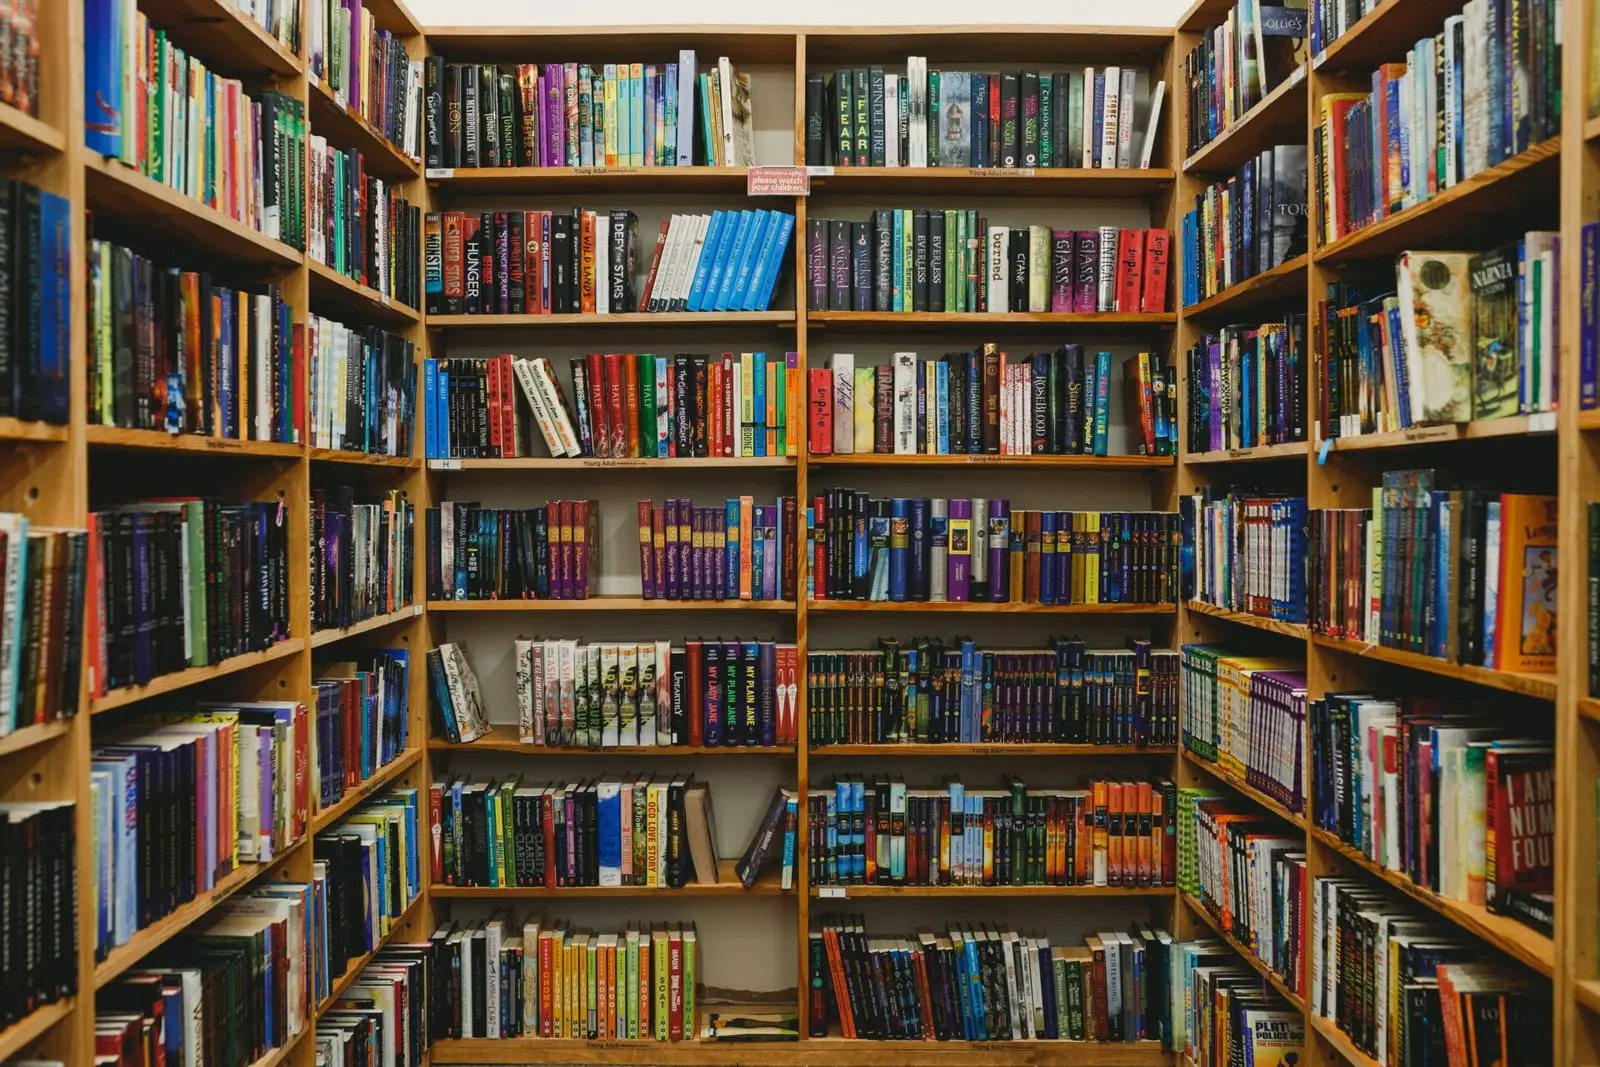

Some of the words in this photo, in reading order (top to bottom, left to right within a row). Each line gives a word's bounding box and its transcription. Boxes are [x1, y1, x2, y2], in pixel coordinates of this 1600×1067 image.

[449, 102, 461, 133] EON
[873, 77, 884, 125] SPINDLE
[466, 100, 476, 152] METROPOLITANS
[483, 111, 497, 142] TUNNELS
[501, 113, 514, 151] TUNNELS
[523, 115, 535, 148] DEEPER
[840, 100, 850, 150] FEAR
[858, 100, 868, 150] FEAR
[874, 129, 884, 153] FIRE
[753, 176, 777, 186] please
[779, 177, 803, 185] watch
[445, 229, 460, 262] SILVER
[583, 236, 593, 263] WILD
[613, 223, 624, 251] DEFY
[426, 232, 440, 284] MONSTER
[467, 242, 480, 298] HUNGER
[814, 244, 827, 287] wicked
[835, 245, 848, 289] wicked
[859, 249, 872, 289] wicked
[879, 231, 891, 287] CRUSADE
[915, 235, 926, 283] EVERLESS
[930, 236, 942, 284] EVERLESS
[991, 232, 1004, 282] burned
[1014, 252, 1026, 285] CRANK
[1059, 239, 1072, 285] GLASS
[1083, 239, 1095, 284] GLASS
[444, 265, 460, 295] STARS
[583, 267, 593, 298] LANDS
[613, 264, 624, 299] STARS
[593, 384, 601, 409] HALF
[611, 384, 620, 409] HALF
[627, 384, 635, 409] HALF
[643, 384, 652, 409] HALF
[1034, 374, 1048, 437] ROSEBLOOD
[1086, 374, 1094, 408] MISSION
[743, 428, 752, 450] BOONE
[708, 667, 717, 678] MY
[727, 666, 736, 678] MY
[746, 666, 755, 678] MY
[673, 671, 684, 717] UNEARTHLY
[708, 680, 717, 700] LADY
[727, 680, 736, 703] PLAIN
[746, 680, 755, 703] PLAIN
[708, 703, 717, 724] JANE
[727, 705, 736, 725] JANE
[746, 705, 755, 726] JANE
[1506, 774, 1515, 806] I
[1524, 770, 1552, 804] AM
[648, 801, 657, 819] OCD
[1510, 804, 1556, 839] NUM
[648, 821, 656, 843] LOVE
[516, 833, 525, 875] CLARITY
[525, 833, 535, 875] CLARITY
[535, 833, 545, 875] CLARITY
[648, 845, 656, 873] STORY
[1512, 835, 1552, 872] FOU
[1110, 951, 1118, 1004] WINTERSONG
[1255, 1021, 1291, 1032] PLAT
